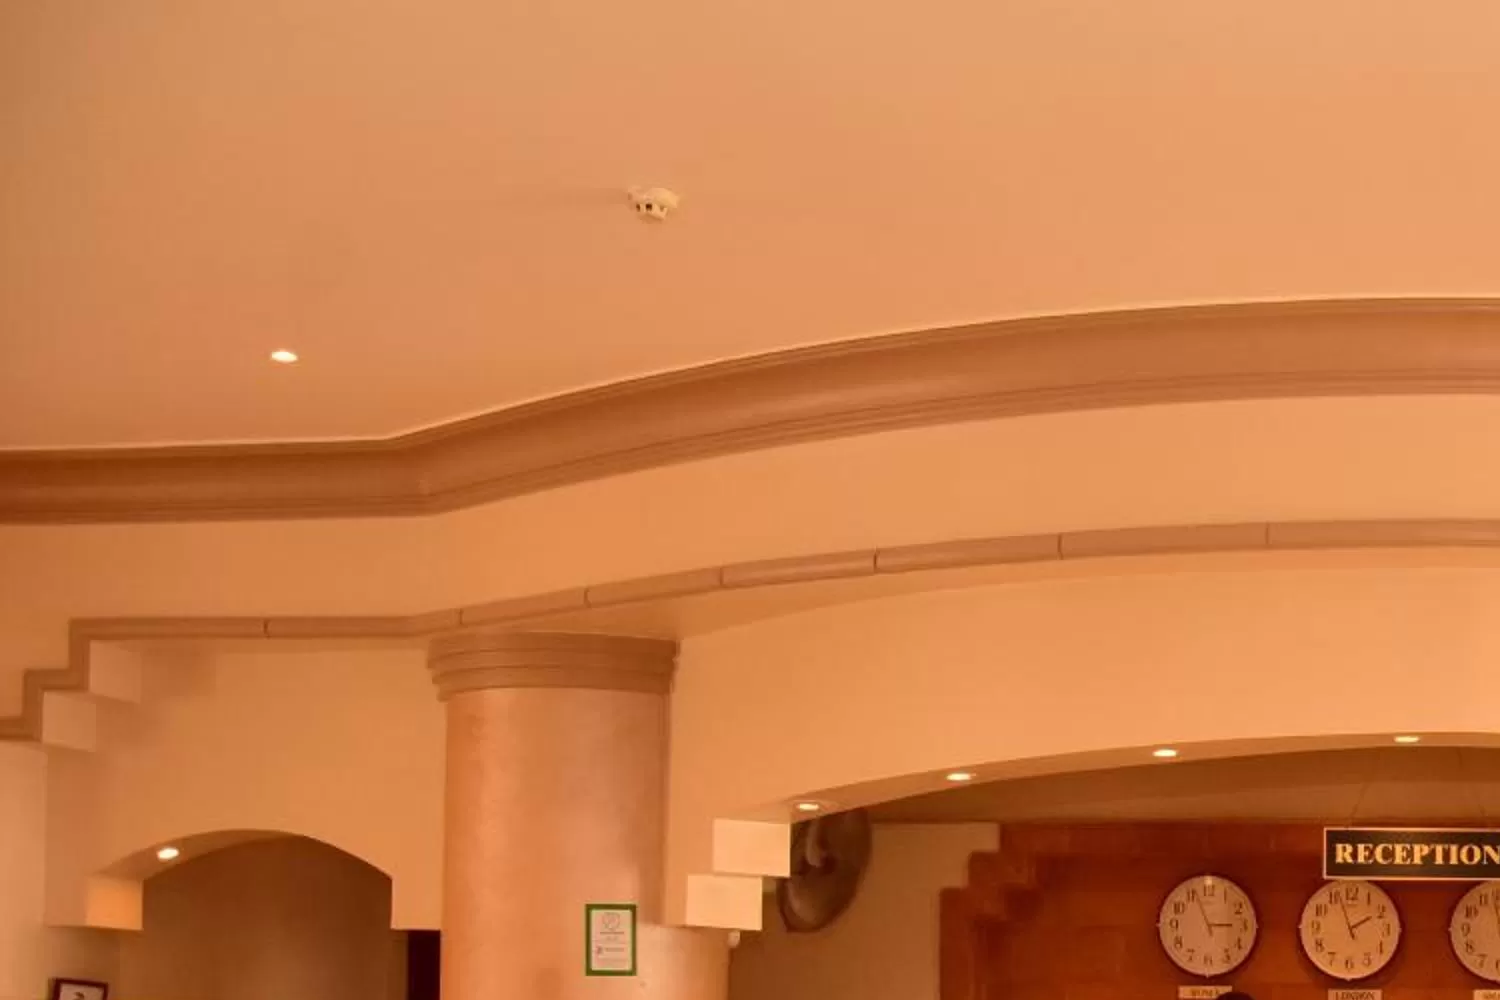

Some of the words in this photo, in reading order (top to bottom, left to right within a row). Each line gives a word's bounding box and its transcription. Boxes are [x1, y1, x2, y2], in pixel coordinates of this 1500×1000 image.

[1186, 889, 1196, 902] 11
[1203, 884, 1215, 896] 12
[1345, 887, 1359, 901] 12
[1329, 890, 1340, 905] 11
[1479, 893, 1489, 906] 11
[1173, 901, 1185, 915] 10
[1234, 901, 1243, 915] 2
[1315, 903, 1328, 917] 10
[1377, 904, 1386, 919] 2
[1465, 904, 1479, 918] 10
[1169, 918, 1179, 931] 9
[1240, 918, 1248, 932] 3
[1311, 920, 1321, 935] 9
[1381, 923, 1391, 937] 3
[1461, 922, 1471, 937] 9
[1174, 935, 1183, 949] 8
[1233, 937, 1242, 950] 4
[1315, 938, 1324, 952] 8
[1376, 940, 1383, 955] 4
[1465, 940, 1474, 954] 8
[1222, 948, 1231, 964] 5
[1327, 952, 1336, 967] 7
[1362, 952, 1372, 967] 5
[1478, 953, 1488, 968] 7
[1344, 957, 1354, 971] 6
[1335, 991, 1375, 1000] LONDON
